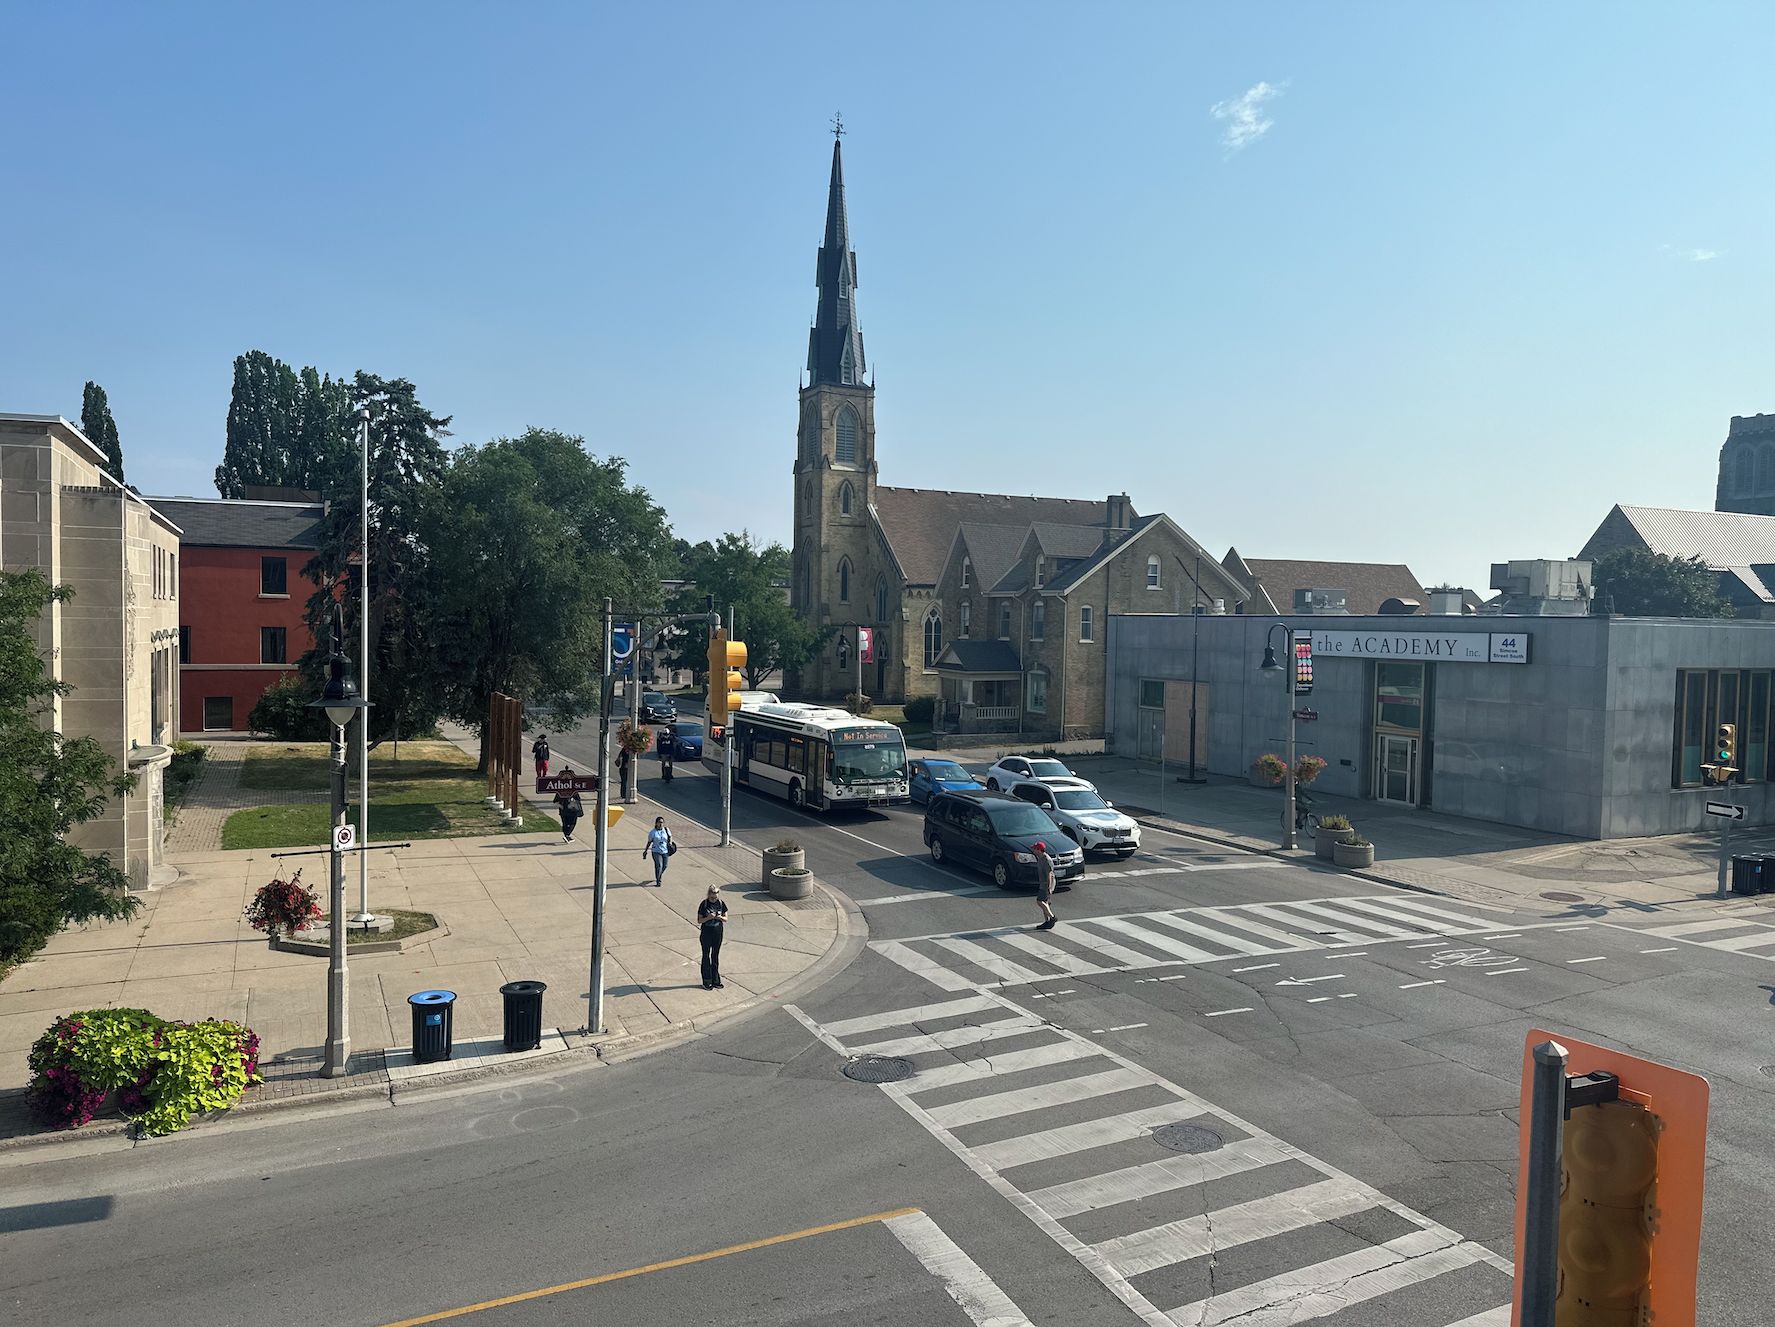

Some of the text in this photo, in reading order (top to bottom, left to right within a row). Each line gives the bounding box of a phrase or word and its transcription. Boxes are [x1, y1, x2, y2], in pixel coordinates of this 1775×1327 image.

[1317, 635, 1481, 657] the ACADEMY Inc.
[1501, 638, 1516, 648] 44
[843, 732, 855, 740] Not
[546, 780, 572, 789] Athol
